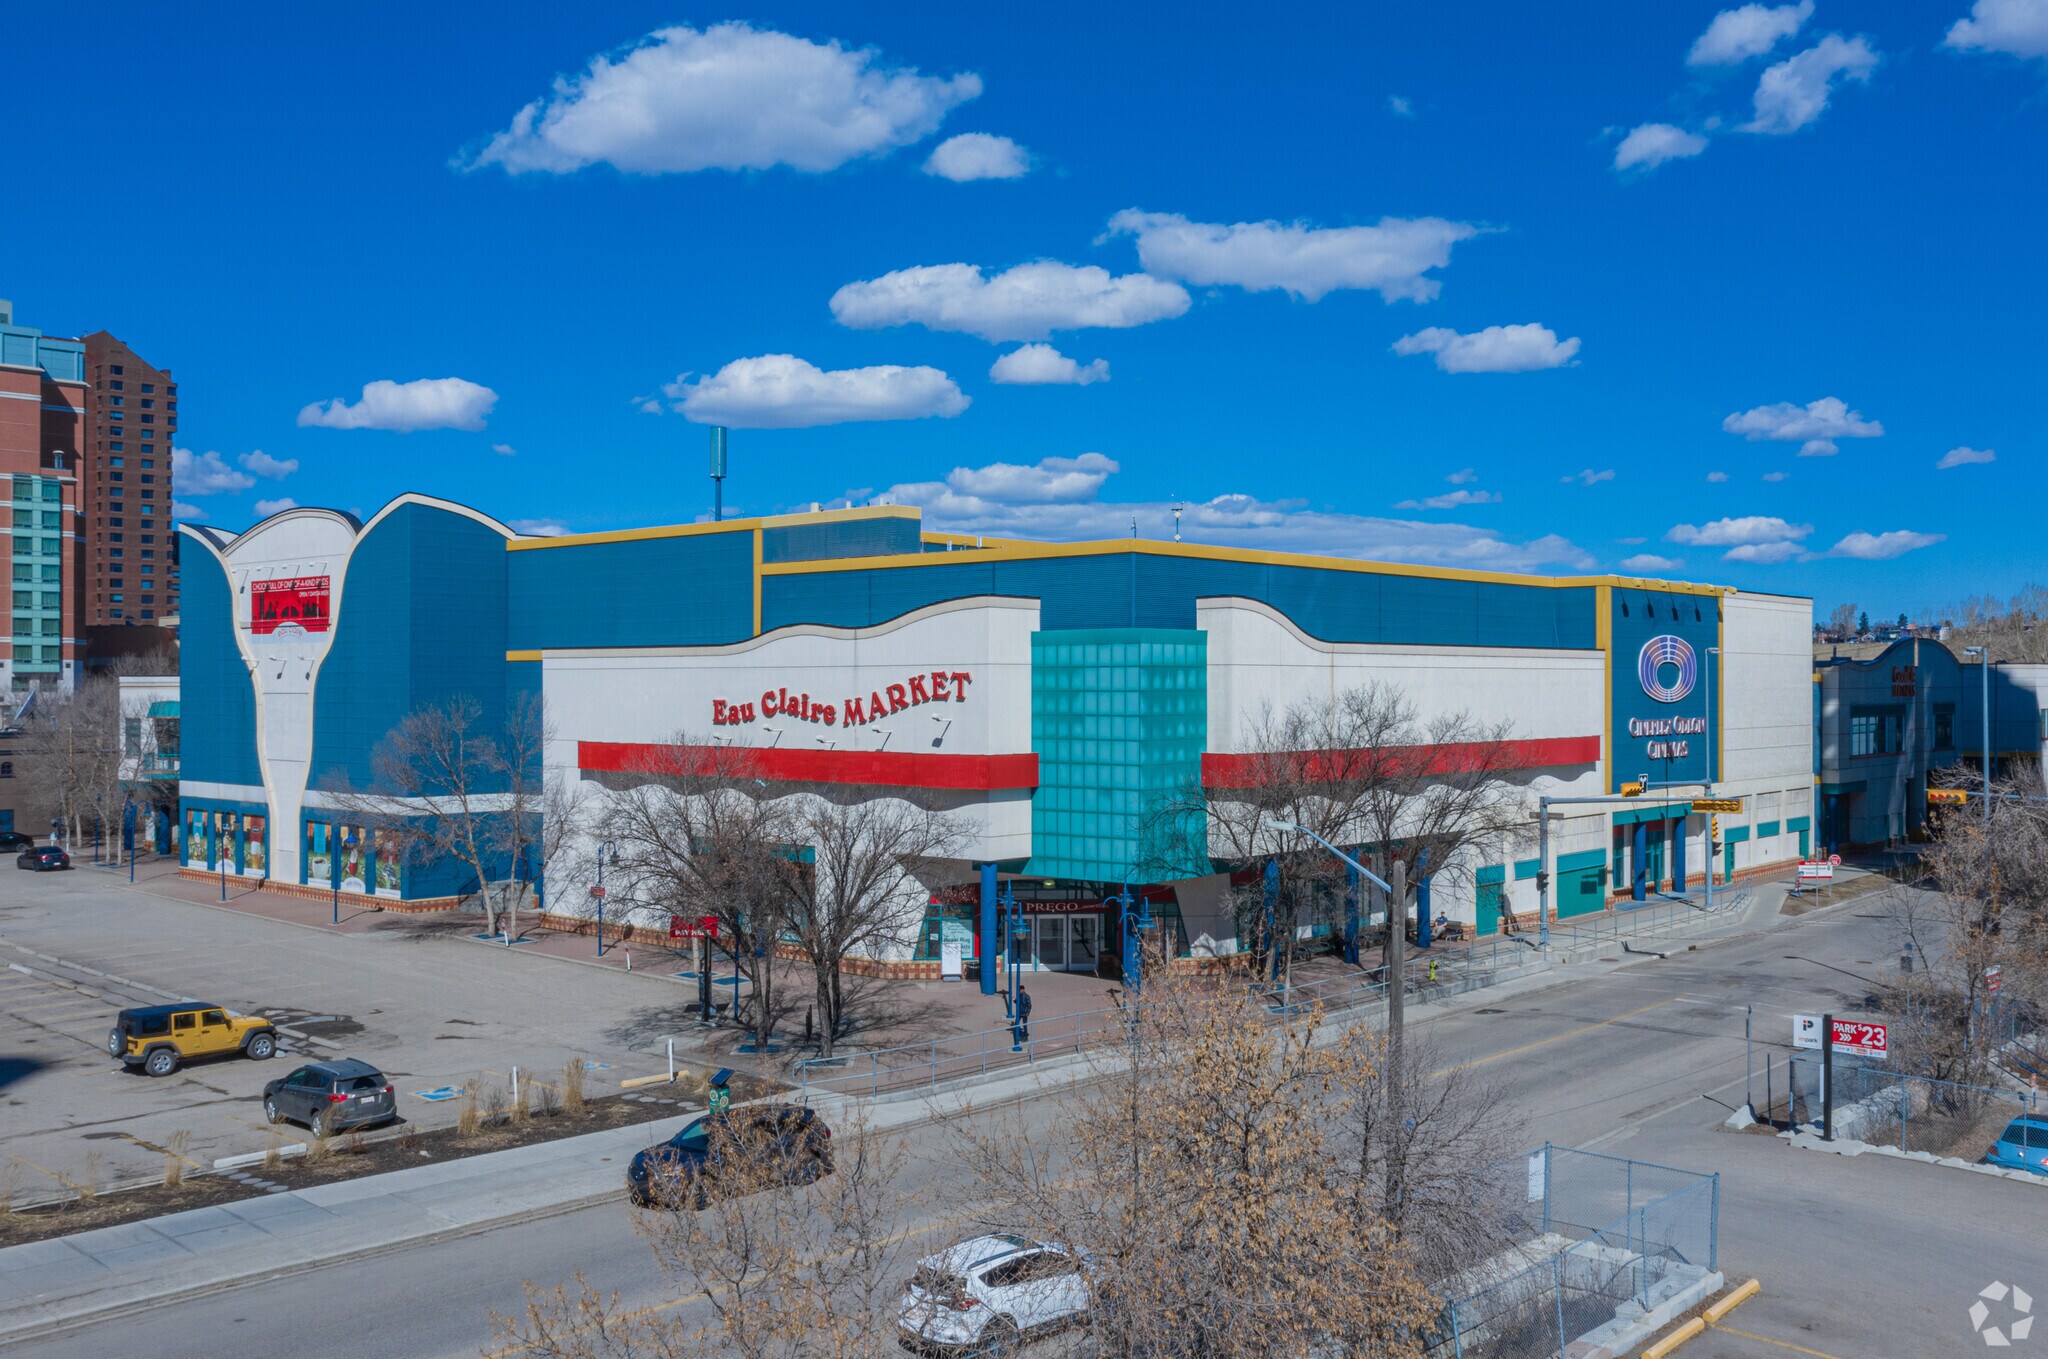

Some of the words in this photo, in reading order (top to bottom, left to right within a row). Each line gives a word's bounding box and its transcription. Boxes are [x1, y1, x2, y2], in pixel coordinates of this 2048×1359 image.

[277, 581, 284, 589] OF
[284, 578, 315, 589] ONEOF-A-KIND
[316, 577, 329, 587] FDS
[713, 699, 755, 725] Eau
[761, 687, 836, 725] Claire
[843, 671, 972, 727] MARKET
[1673, 715, 1706, 735] ODEON
[1026, 902, 1078, 912] PREGO
[1833, 1022, 1857, 1035] PARK
